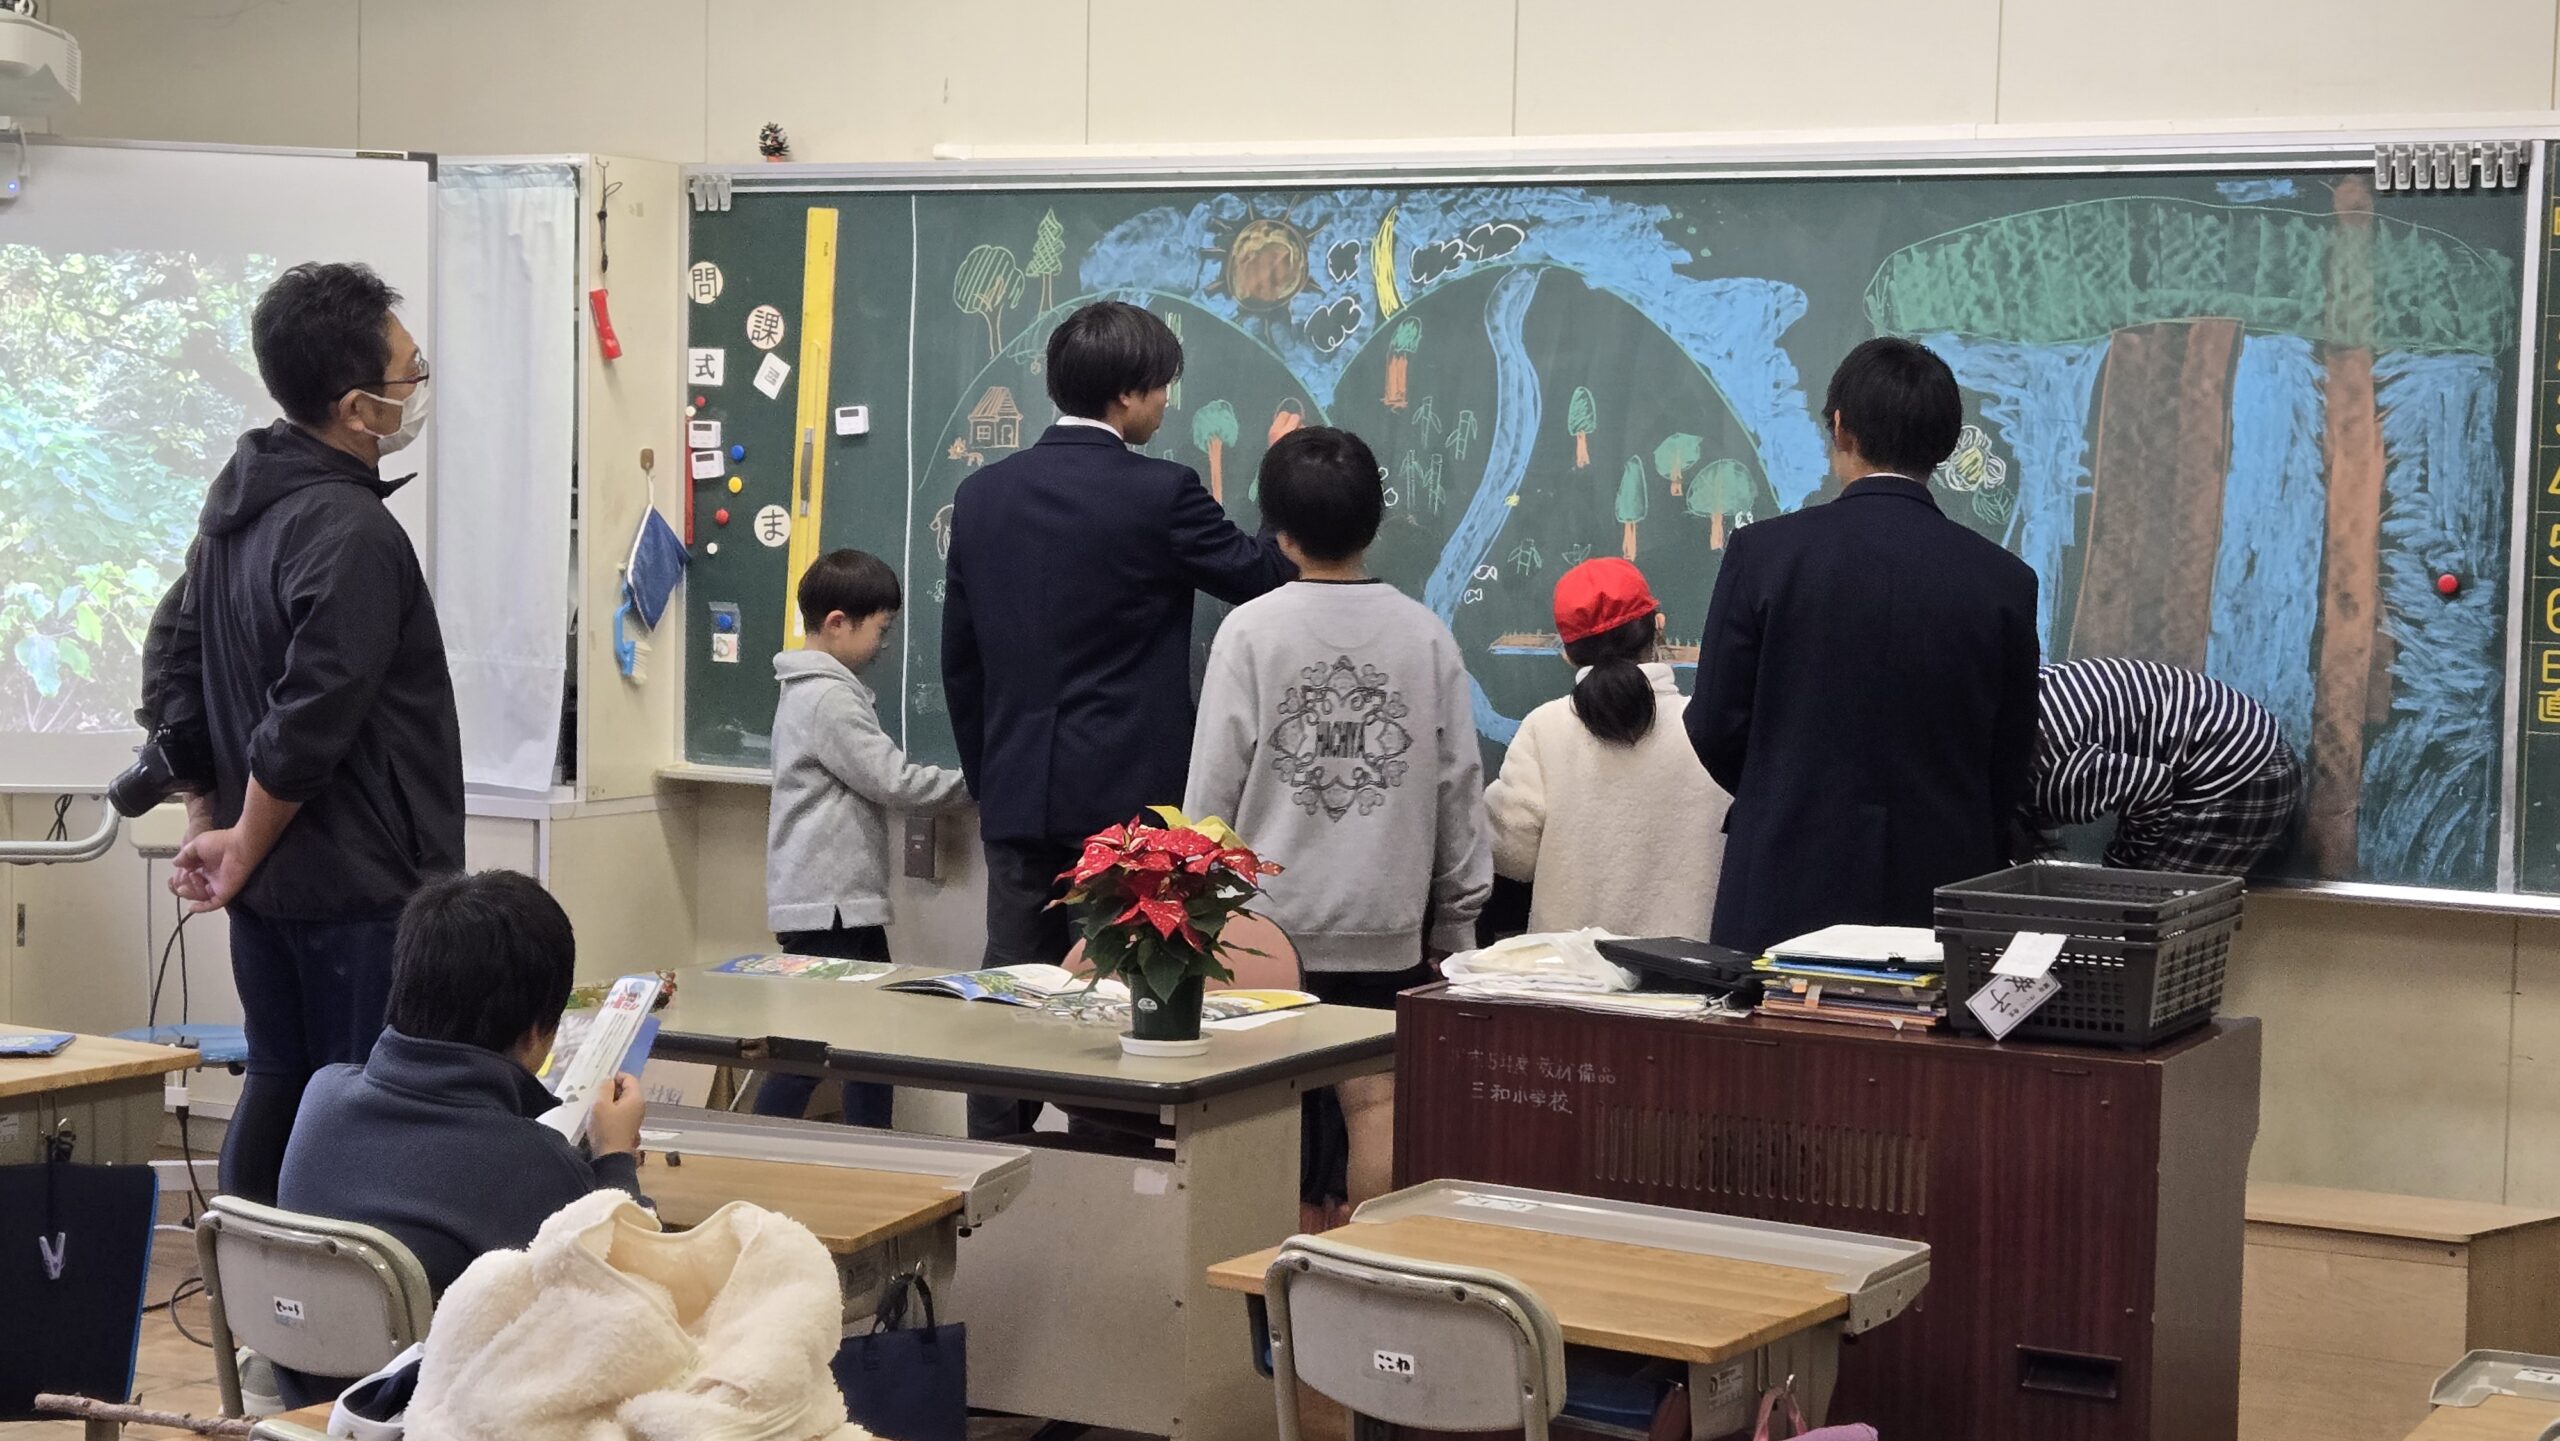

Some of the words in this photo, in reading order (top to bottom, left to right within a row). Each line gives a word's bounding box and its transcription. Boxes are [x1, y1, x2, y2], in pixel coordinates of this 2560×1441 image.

[692, 267, 717, 299] 問
[751, 309, 781, 345] 課
[695, 353, 715, 379] 式
[761, 509, 785, 541] ま
[1471, 1081, 1573, 1114] 三和小学校
[1378, 1354, 1411, 1372] ここね
